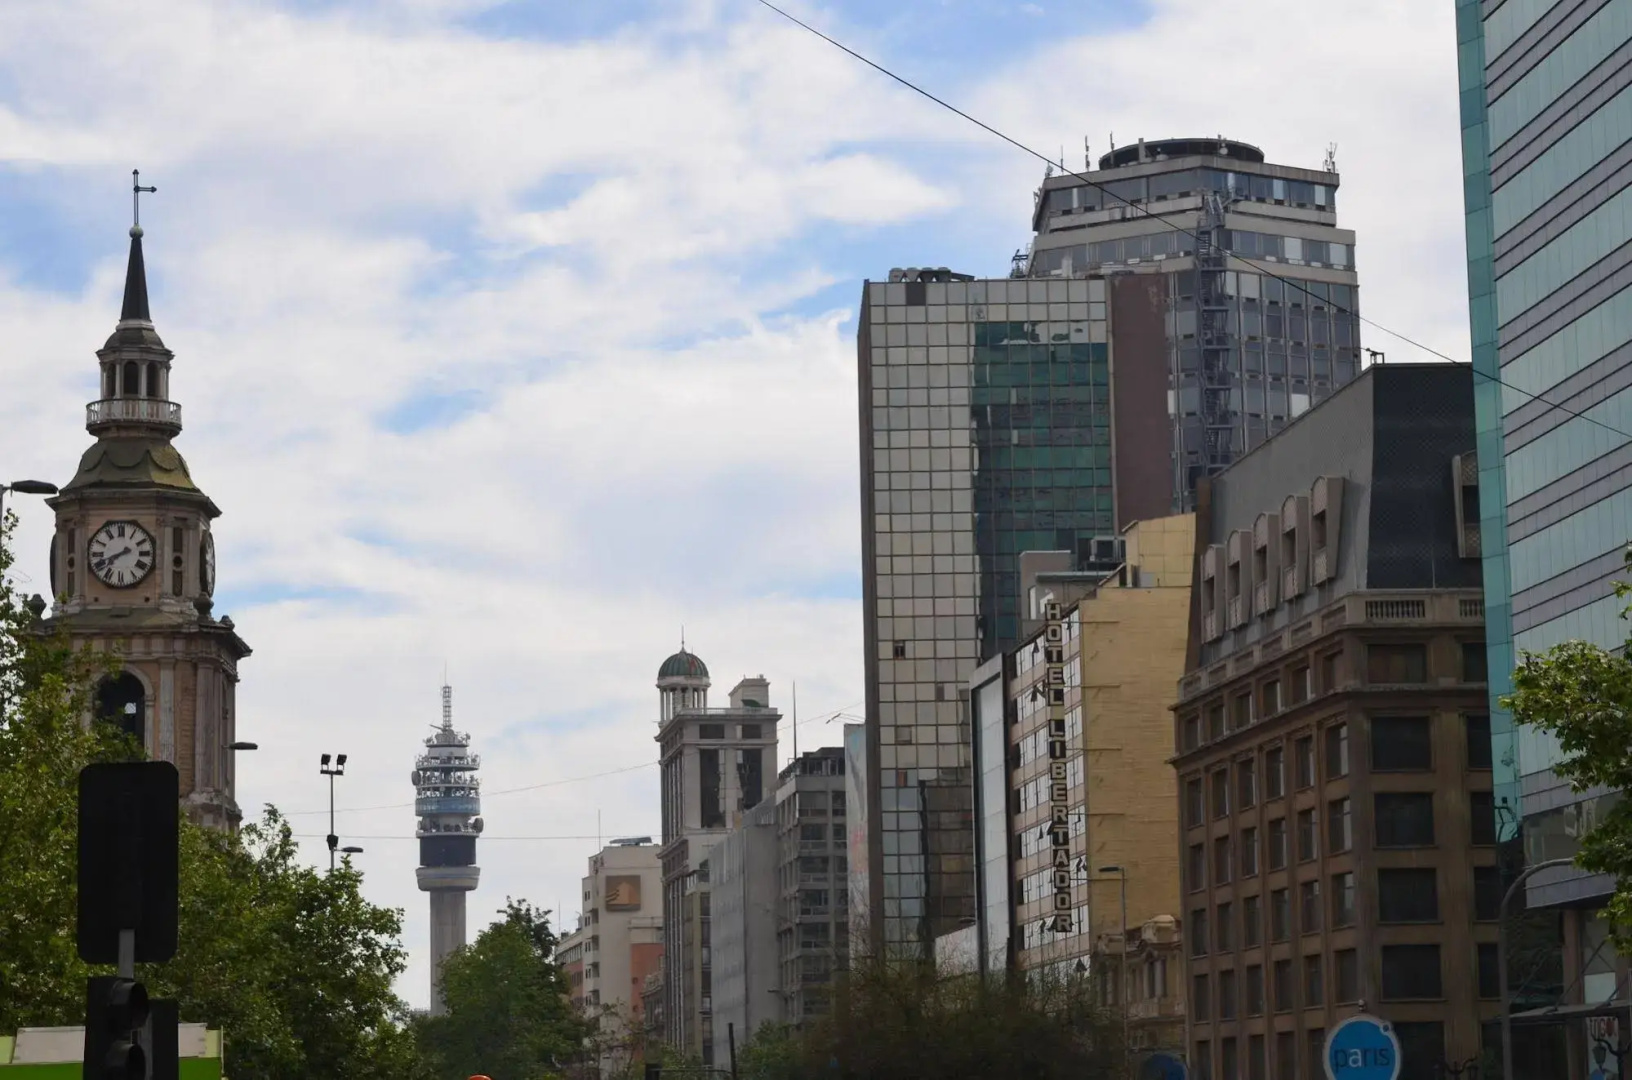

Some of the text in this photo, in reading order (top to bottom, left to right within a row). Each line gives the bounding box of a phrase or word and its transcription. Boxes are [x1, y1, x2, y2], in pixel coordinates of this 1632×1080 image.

[1046, 603, 1072, 931] HOTEL LIBERTADOR
[1334, 1048, 1390, 1074] paris
